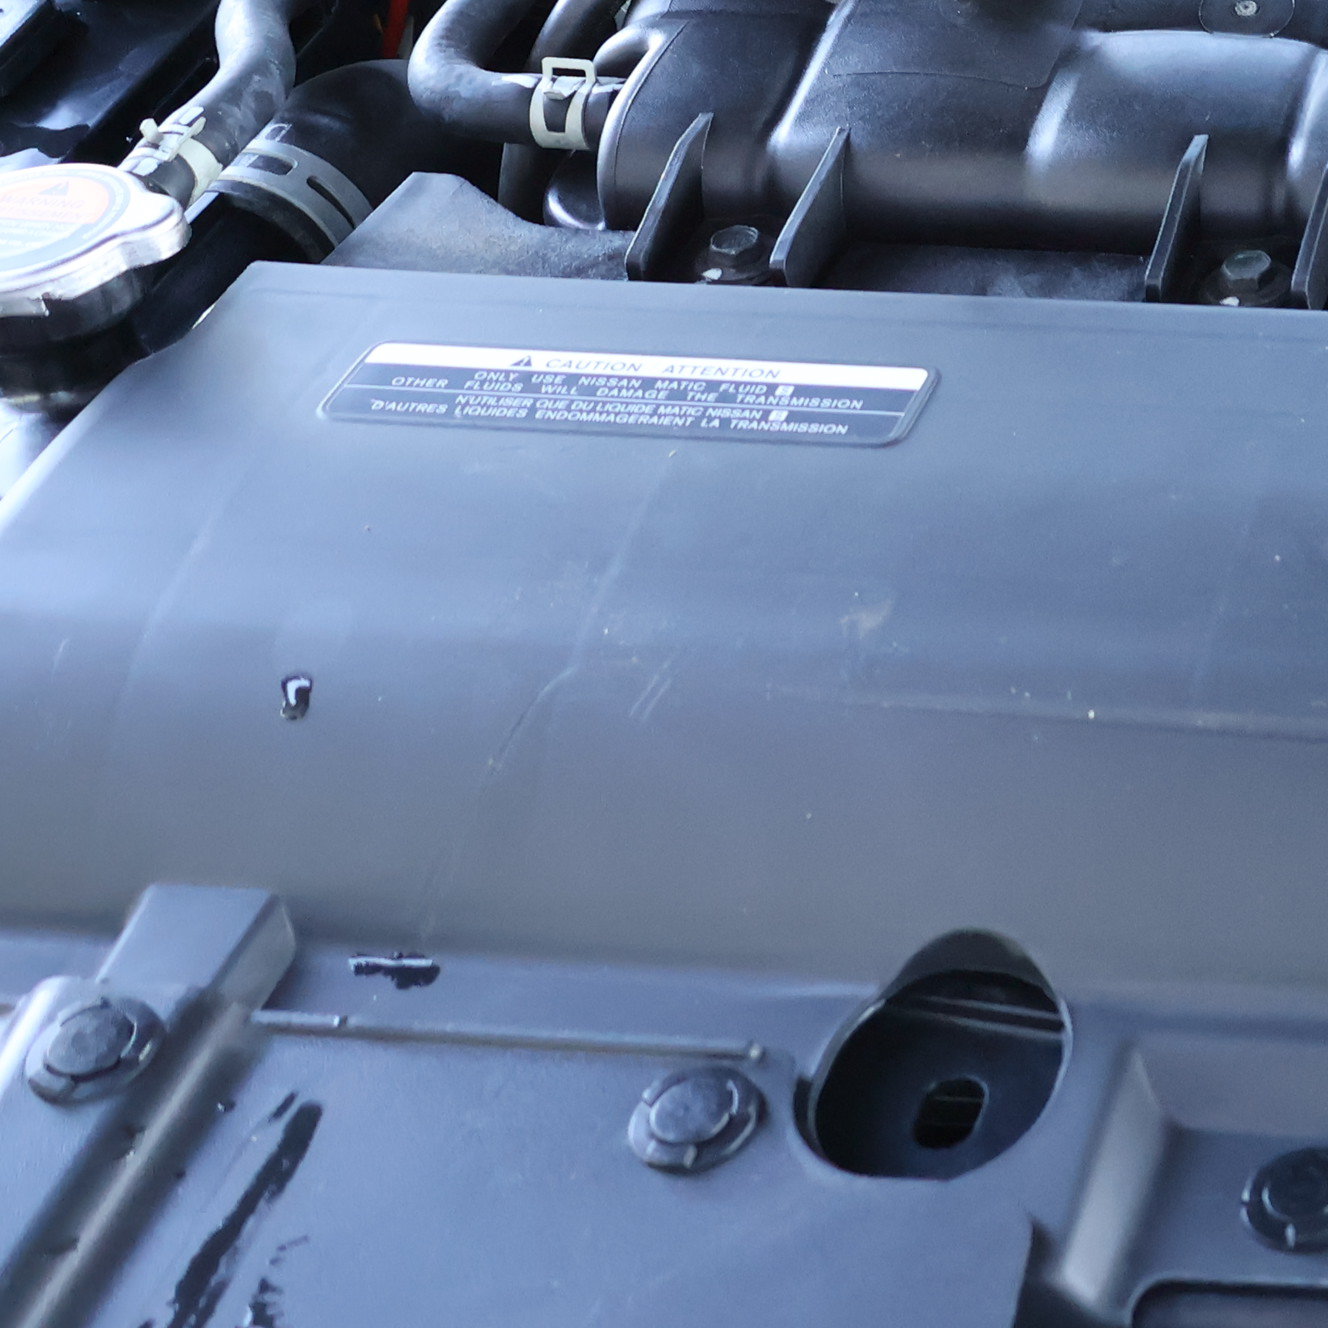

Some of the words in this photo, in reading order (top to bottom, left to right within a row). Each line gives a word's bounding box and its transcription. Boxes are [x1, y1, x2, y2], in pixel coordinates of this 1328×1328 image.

[546, 358, 642, 373] CAUTION
[662, 364, 781, 380] ATTENTION
[391, 376, 449, 388] OTHER
[464, 380, 524, 392] FLUIDS
[541, 384, 578, 395] WILL
[596, 388, 670, 400] DAMAGE
[687, 391, 719, 402] THE
[736, 394, 864, 410] TRANSMISSION
[474, 371, 519, 382] ONLY
[531, 374, 566, 385] USE
[578, 376, 642, 388] NISSAN
[655, 380, 706, 392] MATIC
[719, 383, 767, 394] FLUID
[371, 399, 449, 414] D'AUTRES
[455, 406, 528, 418] LIQUIDES
[535, 409, 697, 427] ENDOMMAGERAIENT
[701, 418, 720, 428] LA
[730, 419, 849, 435] TRANSMISSION
[536, 399, 569, 410] QUE
[571, 400, 594, 411] DU
[596, 402, 655, 414] LIQUIDE
[657, 405, 704, 416] MATIC
[706, 407, 762, 419] NISSAN
